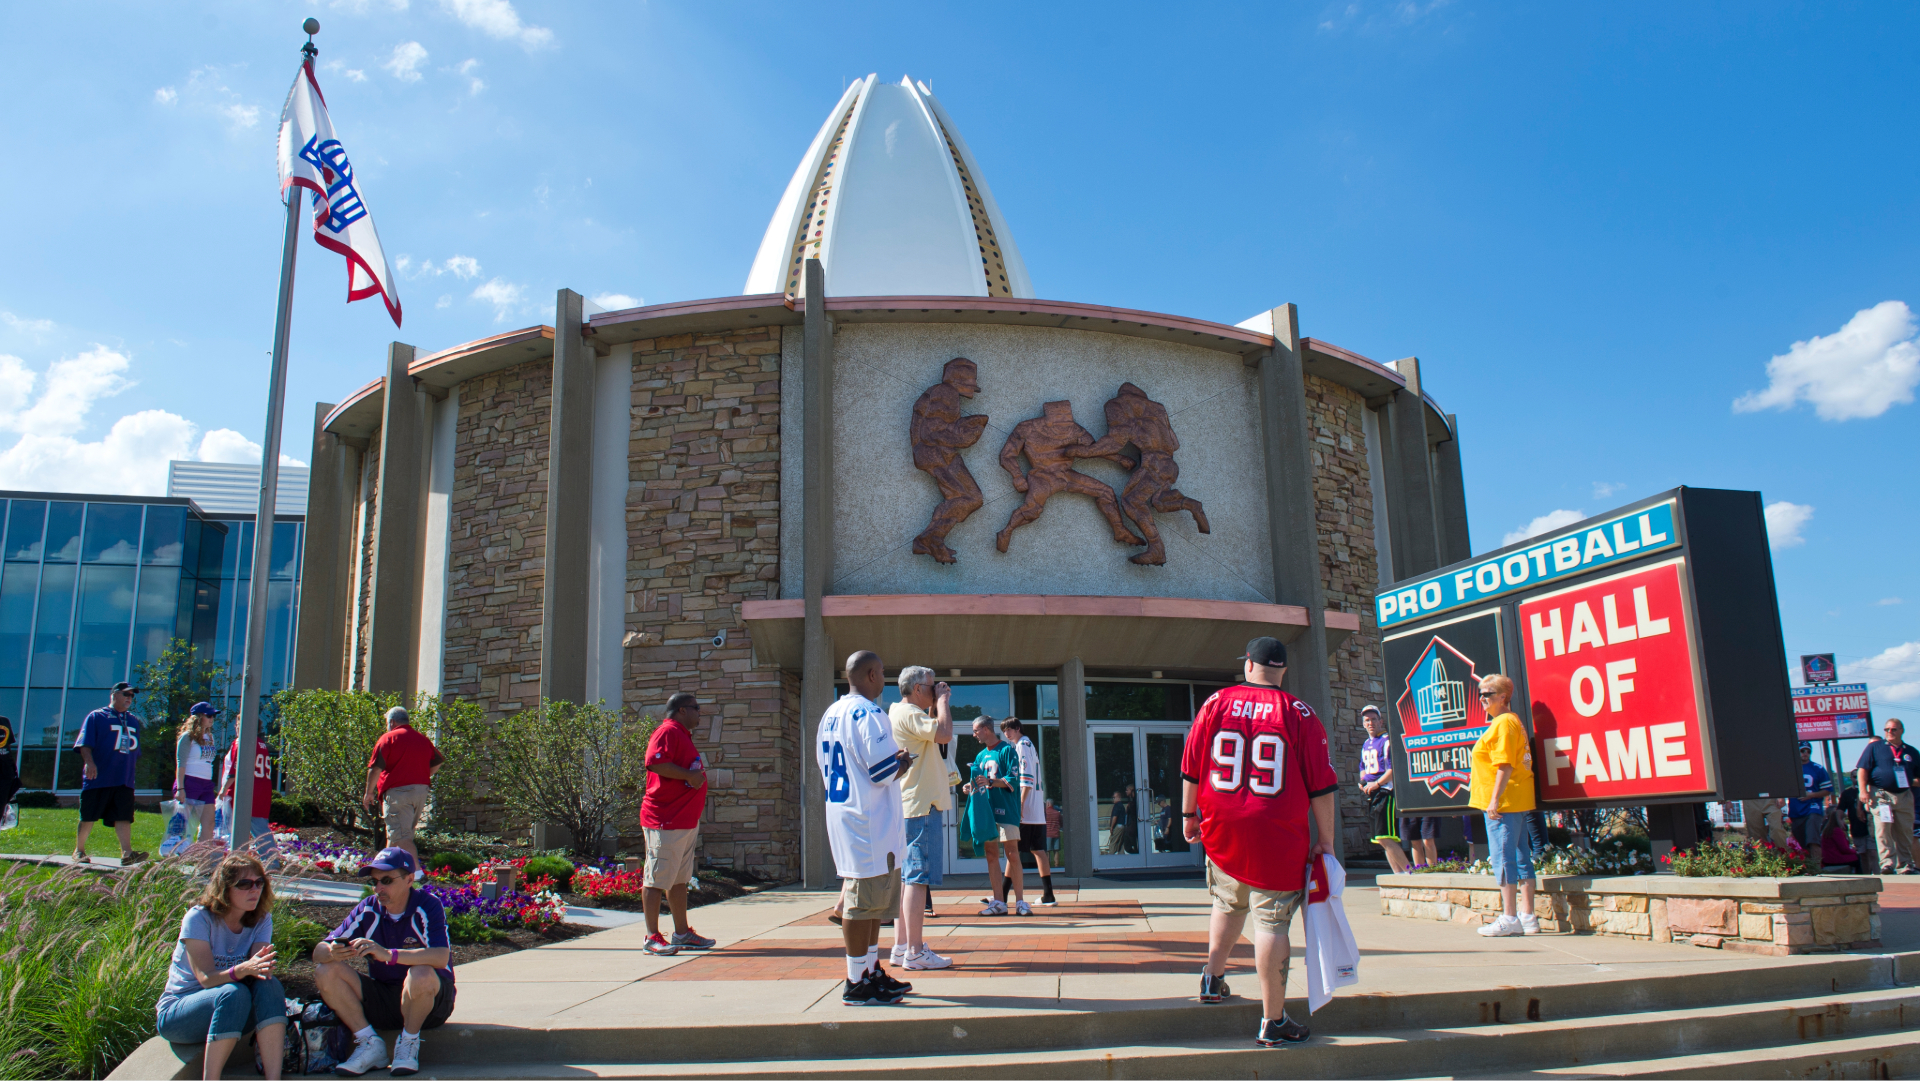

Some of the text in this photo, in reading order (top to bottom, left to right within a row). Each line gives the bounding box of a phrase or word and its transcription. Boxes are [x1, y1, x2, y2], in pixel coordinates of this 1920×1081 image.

[1378, 513, 1668, 623] PRO FOOTBALL
[1529, 585, 1672, 661] HALL
[1231, 699, 1273, 720] SAPP
[1569, 657, 1638, 718] OF
[1793, 695, 1868, 713] ALL OF FAME
[1809, 685, 1864, 694] FOOTBALL
[110, 724, 139, 751] 75
[1407, 737, 1428, 747] PRO
[1543, 720, 1692, 786] FAME
[822, 741, 850, 803] 8
[1210, 727, 1288, 799] 99
[1412, 747, 1472, 773] HALL OF FA
